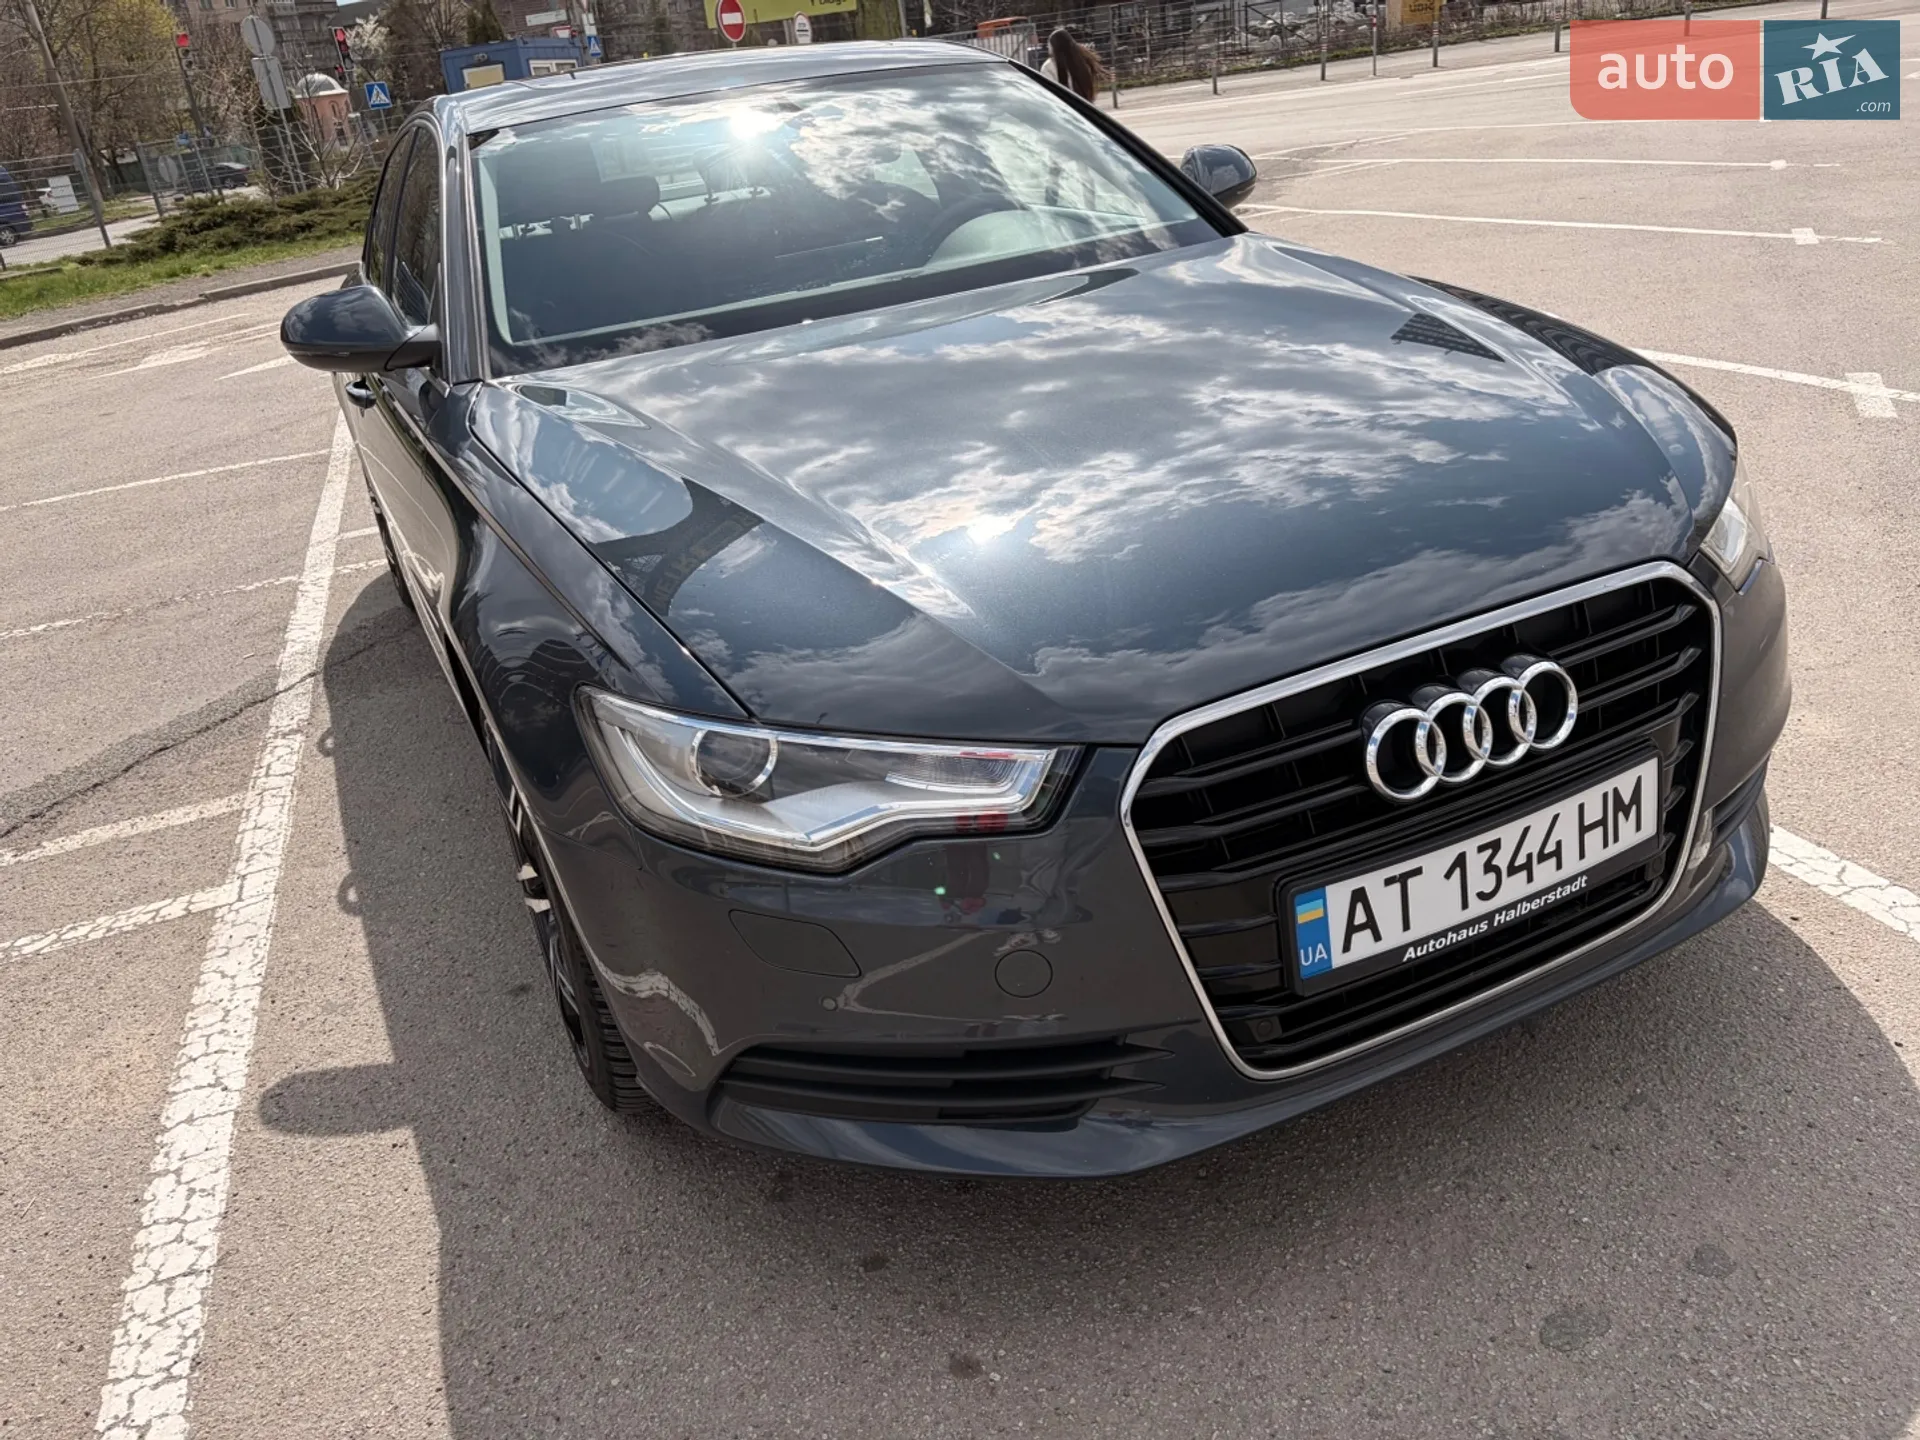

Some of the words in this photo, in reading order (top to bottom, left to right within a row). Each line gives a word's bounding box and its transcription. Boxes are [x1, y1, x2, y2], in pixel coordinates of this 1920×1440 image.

[1342, 866, 1423, 955] AT
[1443, 812, 1563, 911] 1344
[1578, 775, 1642, 861] HM
[1300, 943, 1328, 966] UA
[1403, 919, 1488, 962] Autohaus
[1493, 874, 1588, 927] Halberstadt
